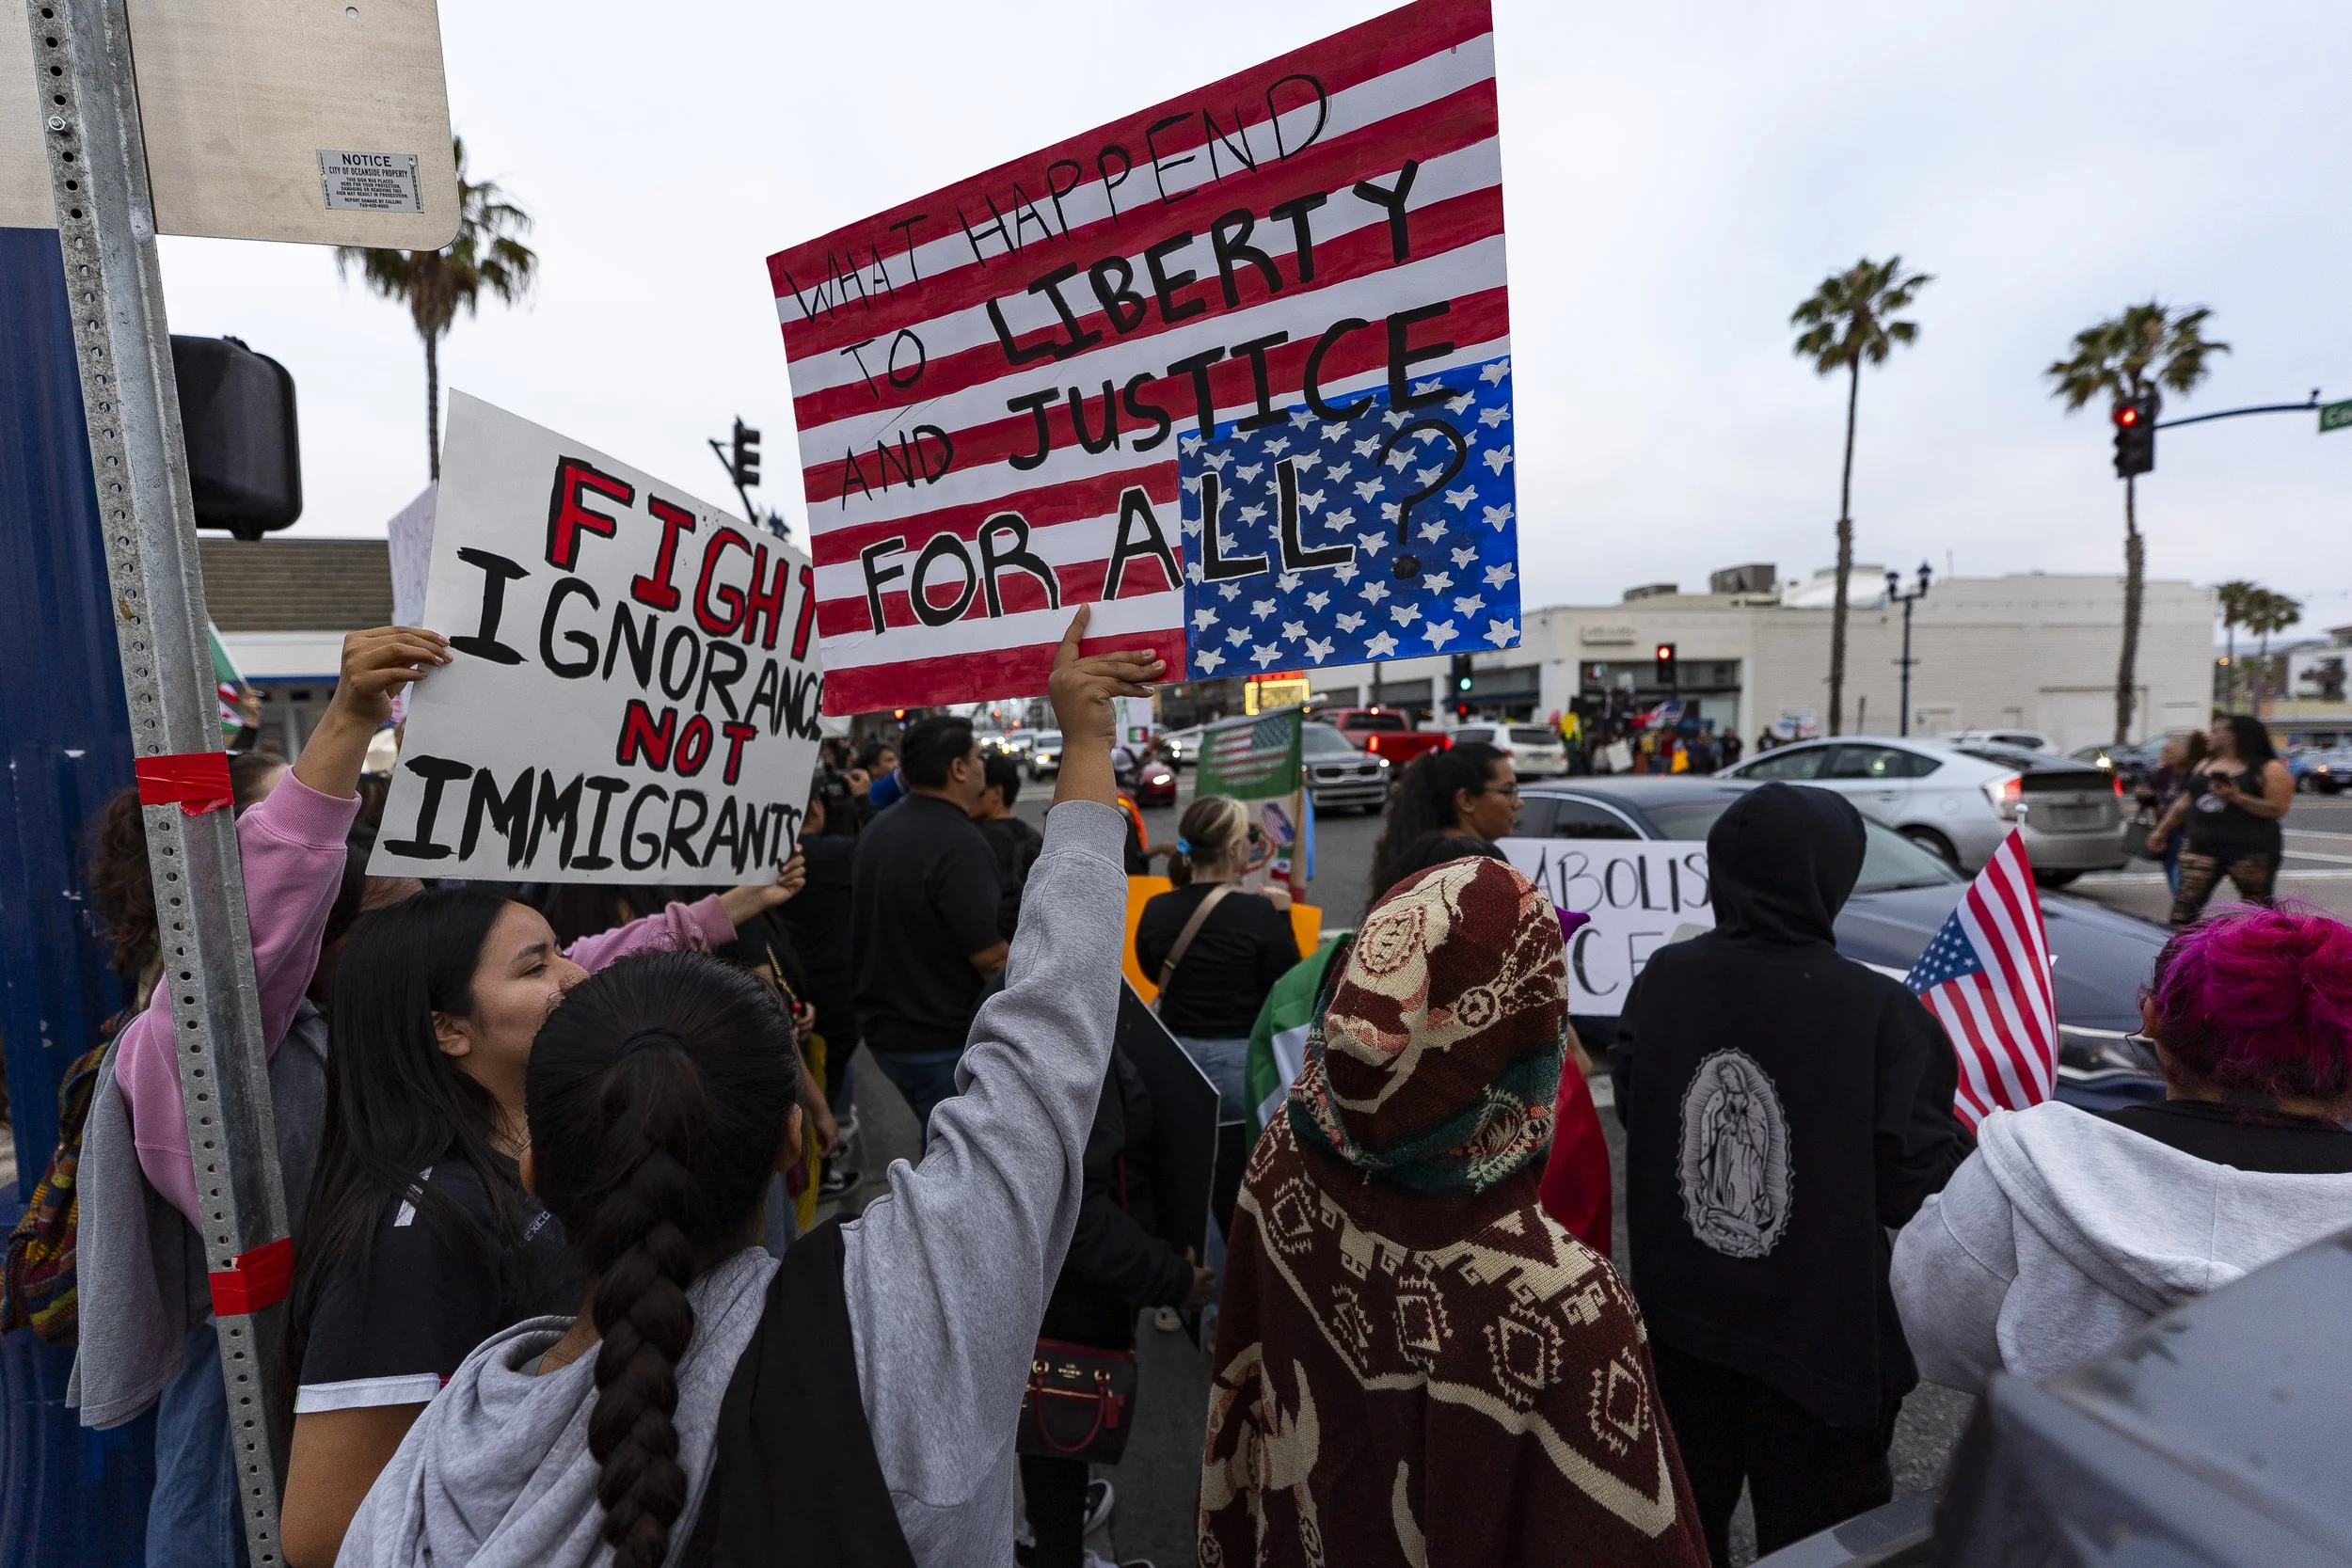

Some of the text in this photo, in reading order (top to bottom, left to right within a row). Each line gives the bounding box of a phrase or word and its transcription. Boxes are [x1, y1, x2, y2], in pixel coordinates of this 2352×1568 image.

[329, 166, 340, 175] CITY
[351, 167, 380, 177] OCEANSIDE
[382, 169, 408, 178] PROPERTY
[342, 154, 392, 167] NOTICE
[784, 74, 1332, 324] WHAT HAPPEND
[840, 159, 1419, 400] TO LIBERTY
[842, 301, 1461, 511] AND JUSTICE
[544, 454, 818, 663] FIGHT
[860, 419, 1467, 636] FOR ALL ?
[450, 546, 824, 741] IGNORANCE
[383, 755, 803, 875] IMMIGRANTS
[616, 699, 759, 785] NOT
[1531, 847, 1712, 914] ABOLIS
